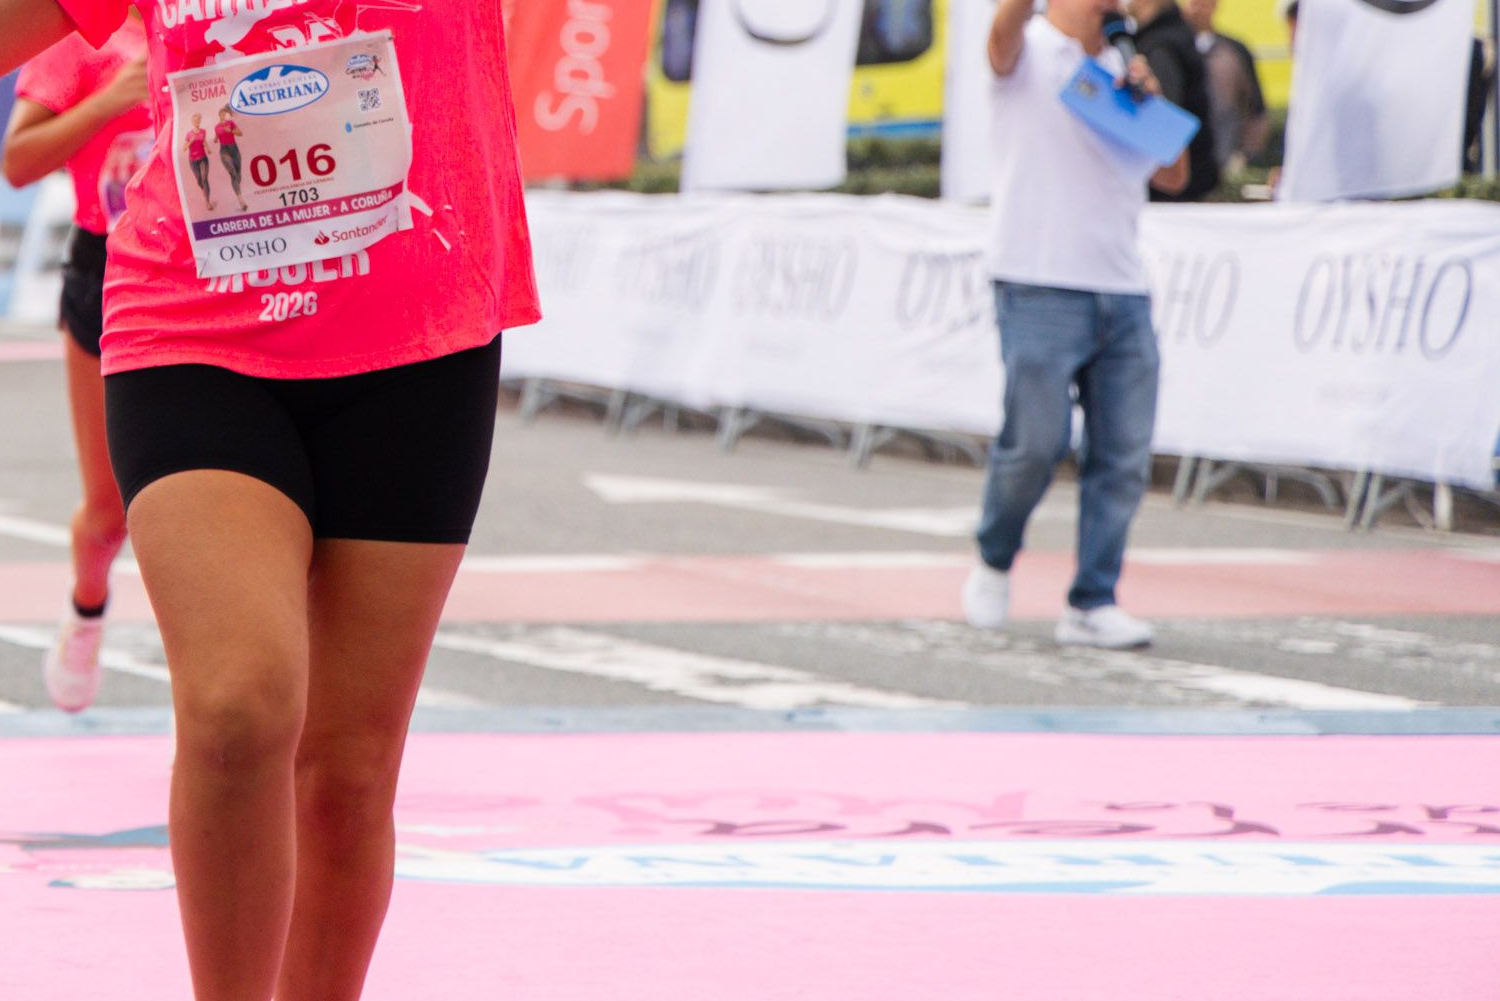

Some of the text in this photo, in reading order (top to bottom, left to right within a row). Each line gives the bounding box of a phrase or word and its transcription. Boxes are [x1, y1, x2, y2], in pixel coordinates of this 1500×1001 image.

[191, 85, 227, 103] SUMA
[237, 80, 323, 108] ASTURIANA
[250, 143, 336, 187] 016
[210, 190, 393, 235] CARRERA DE LA MUJER A CORUÑA
[279, 187, 320, 207] 1703
[219, 214, 388, 262] OYSHO Santander
[258, 291, 319, 322] 2026
[1294, 250, 1473, 362] OYSHO
